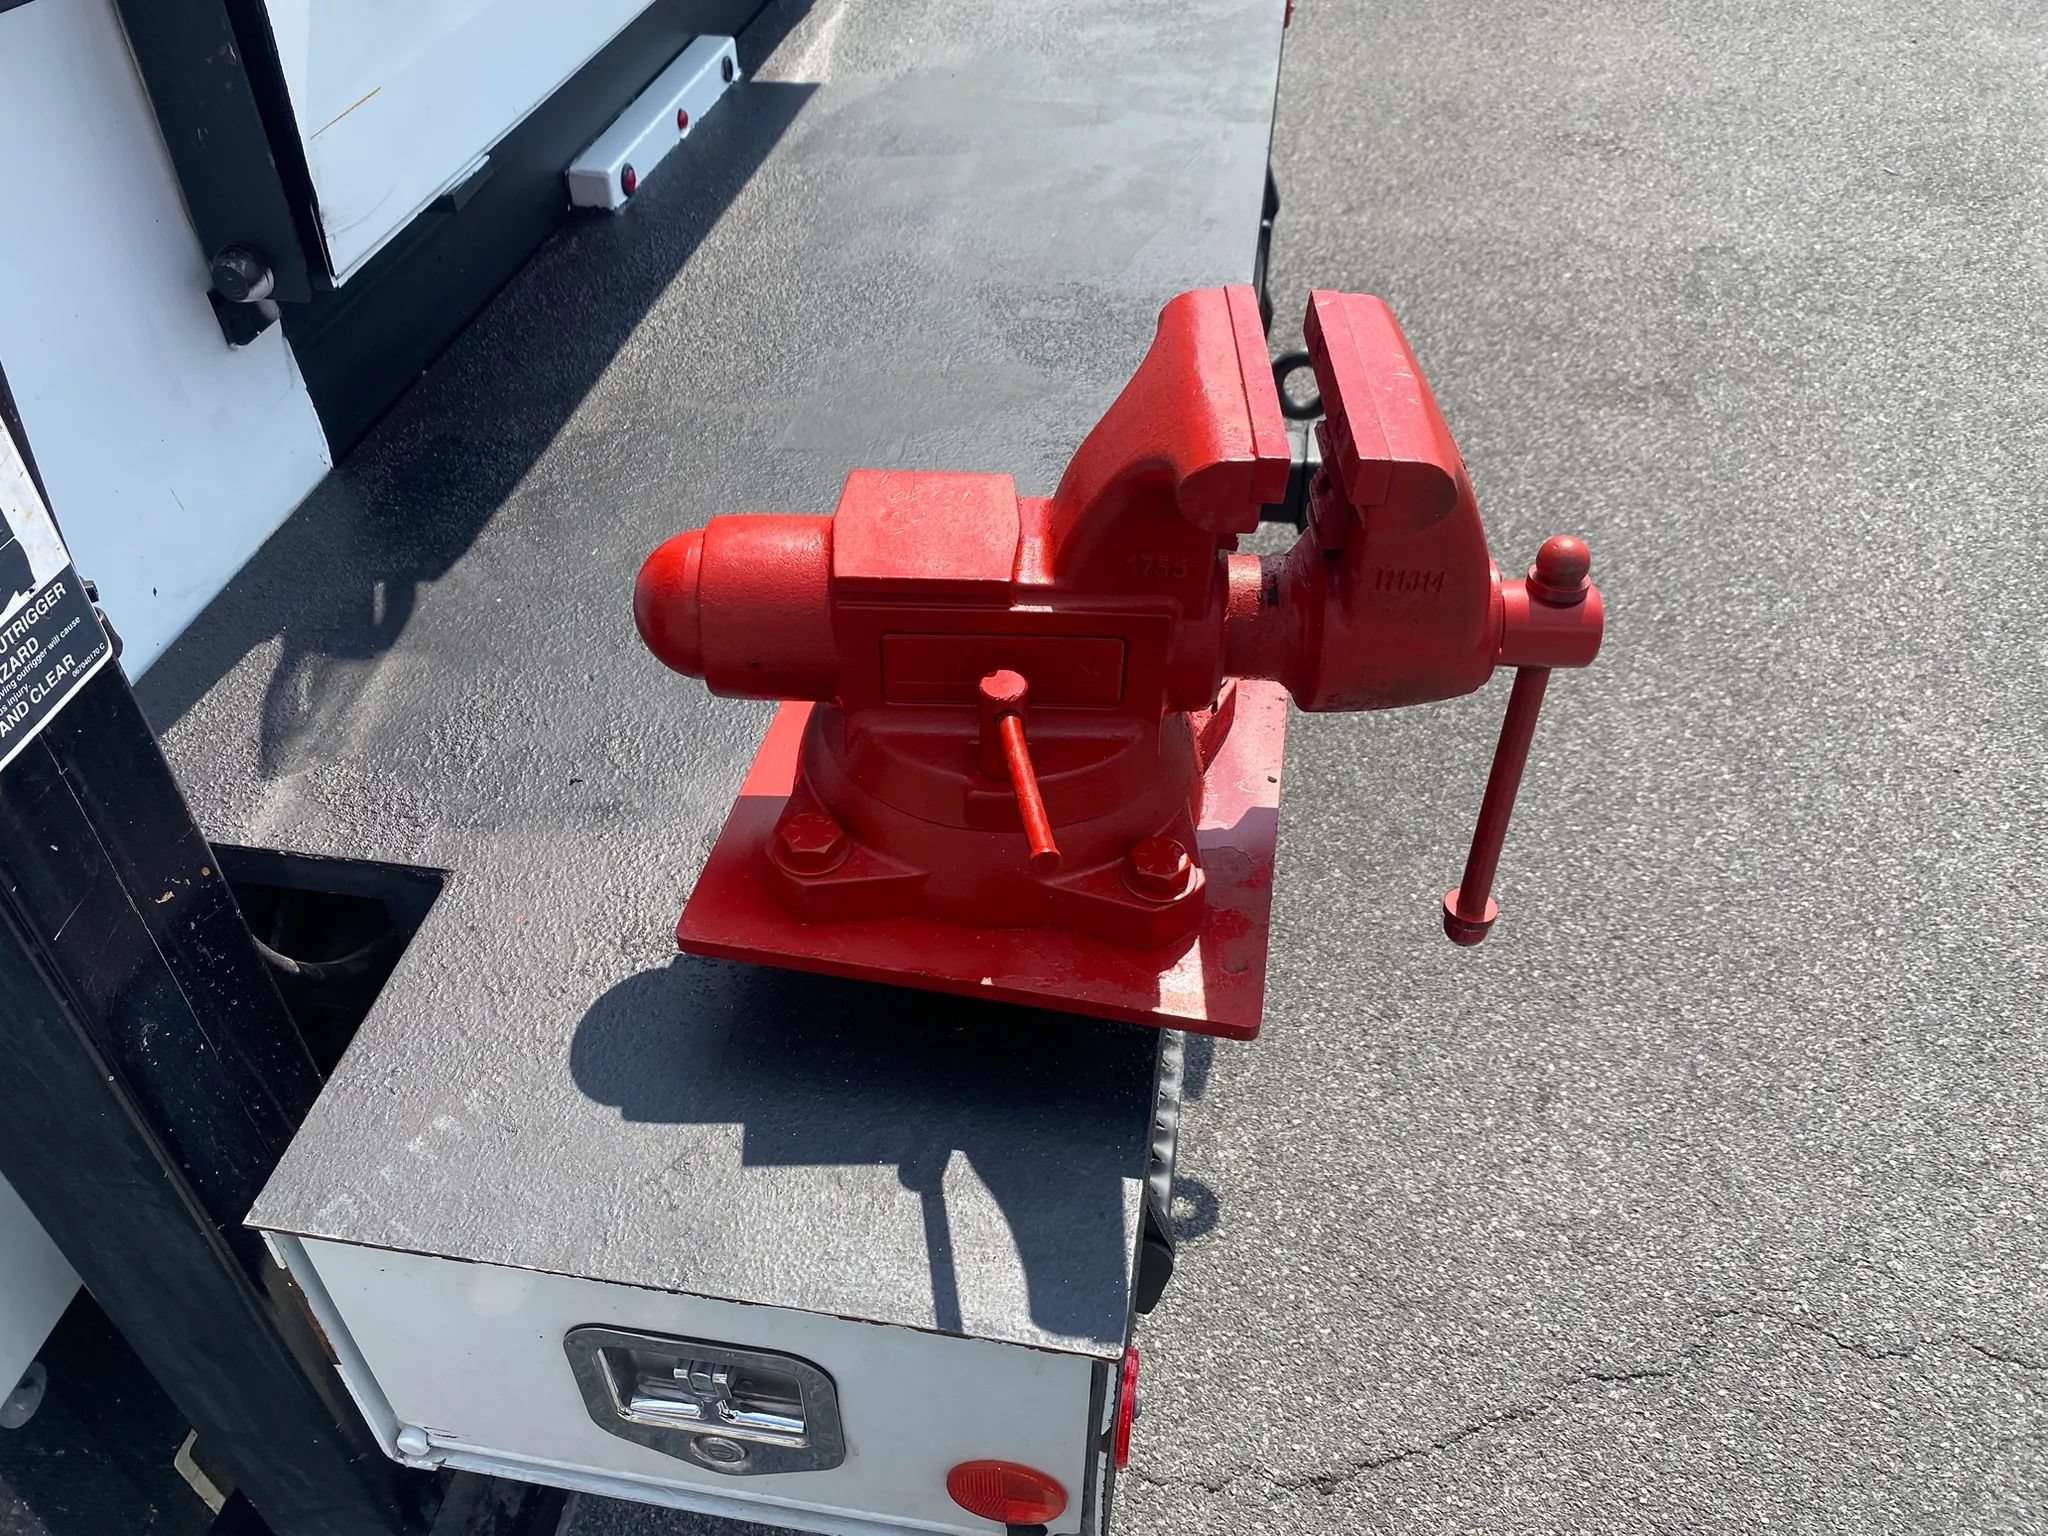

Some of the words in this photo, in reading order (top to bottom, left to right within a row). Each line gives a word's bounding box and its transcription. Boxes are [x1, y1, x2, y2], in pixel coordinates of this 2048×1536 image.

[0, 637, 39, 684] ZARD
[16, 648, 47, 681] outrigger
[47, 634, 60, 650] will
[60, 616, 81, 638] cause
[6, 683, 31, 706] injury.
[30, 653, 76, 704] CLEAR
